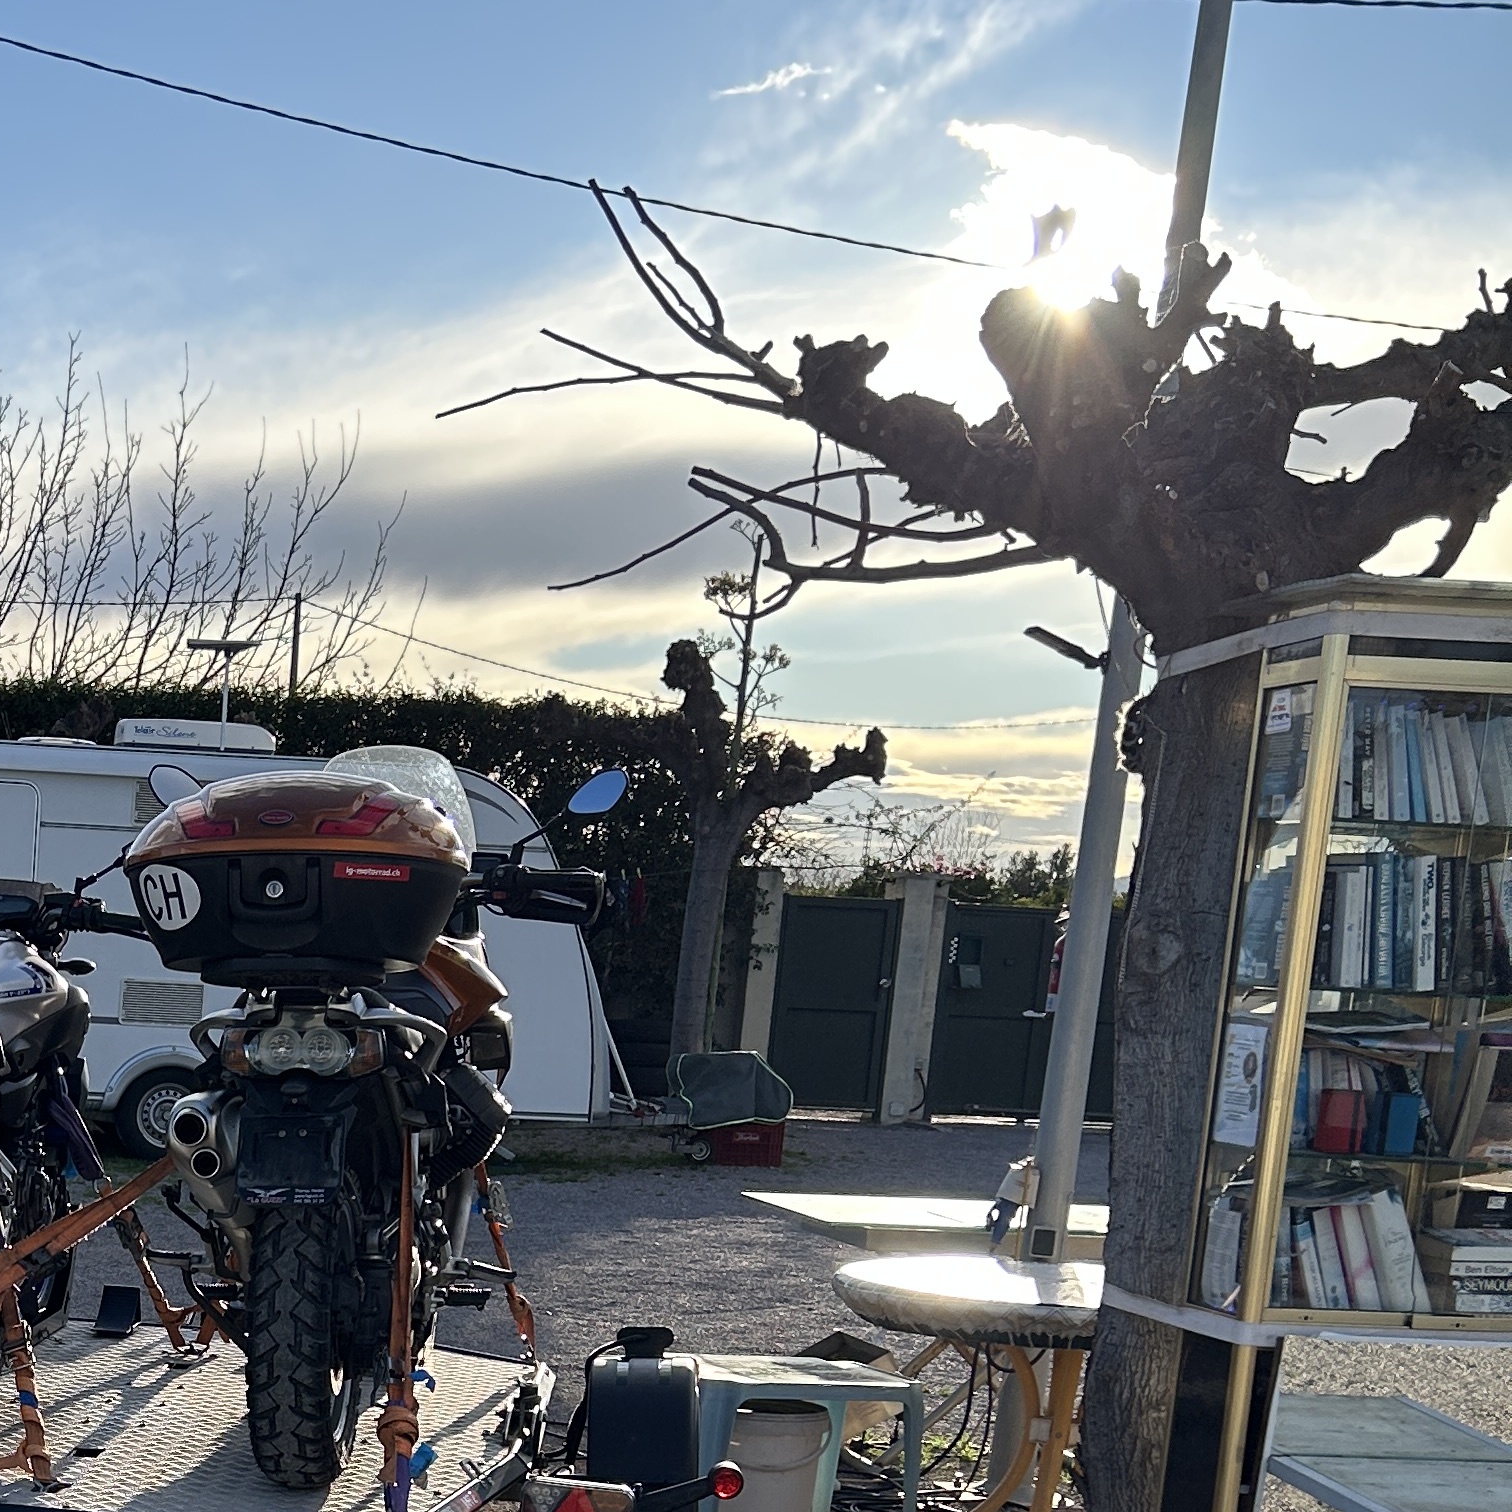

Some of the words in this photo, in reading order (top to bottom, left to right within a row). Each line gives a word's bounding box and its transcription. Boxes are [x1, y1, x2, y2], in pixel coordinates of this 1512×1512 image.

[1427, 862, 1435, 889] TWO
[143, 871, 187, 922] CH
[1419, 933, 1428, 967] George
[1465, 1265, 1482, 1274] Ben
[1484, 1265, 1509, 1274] Elton
